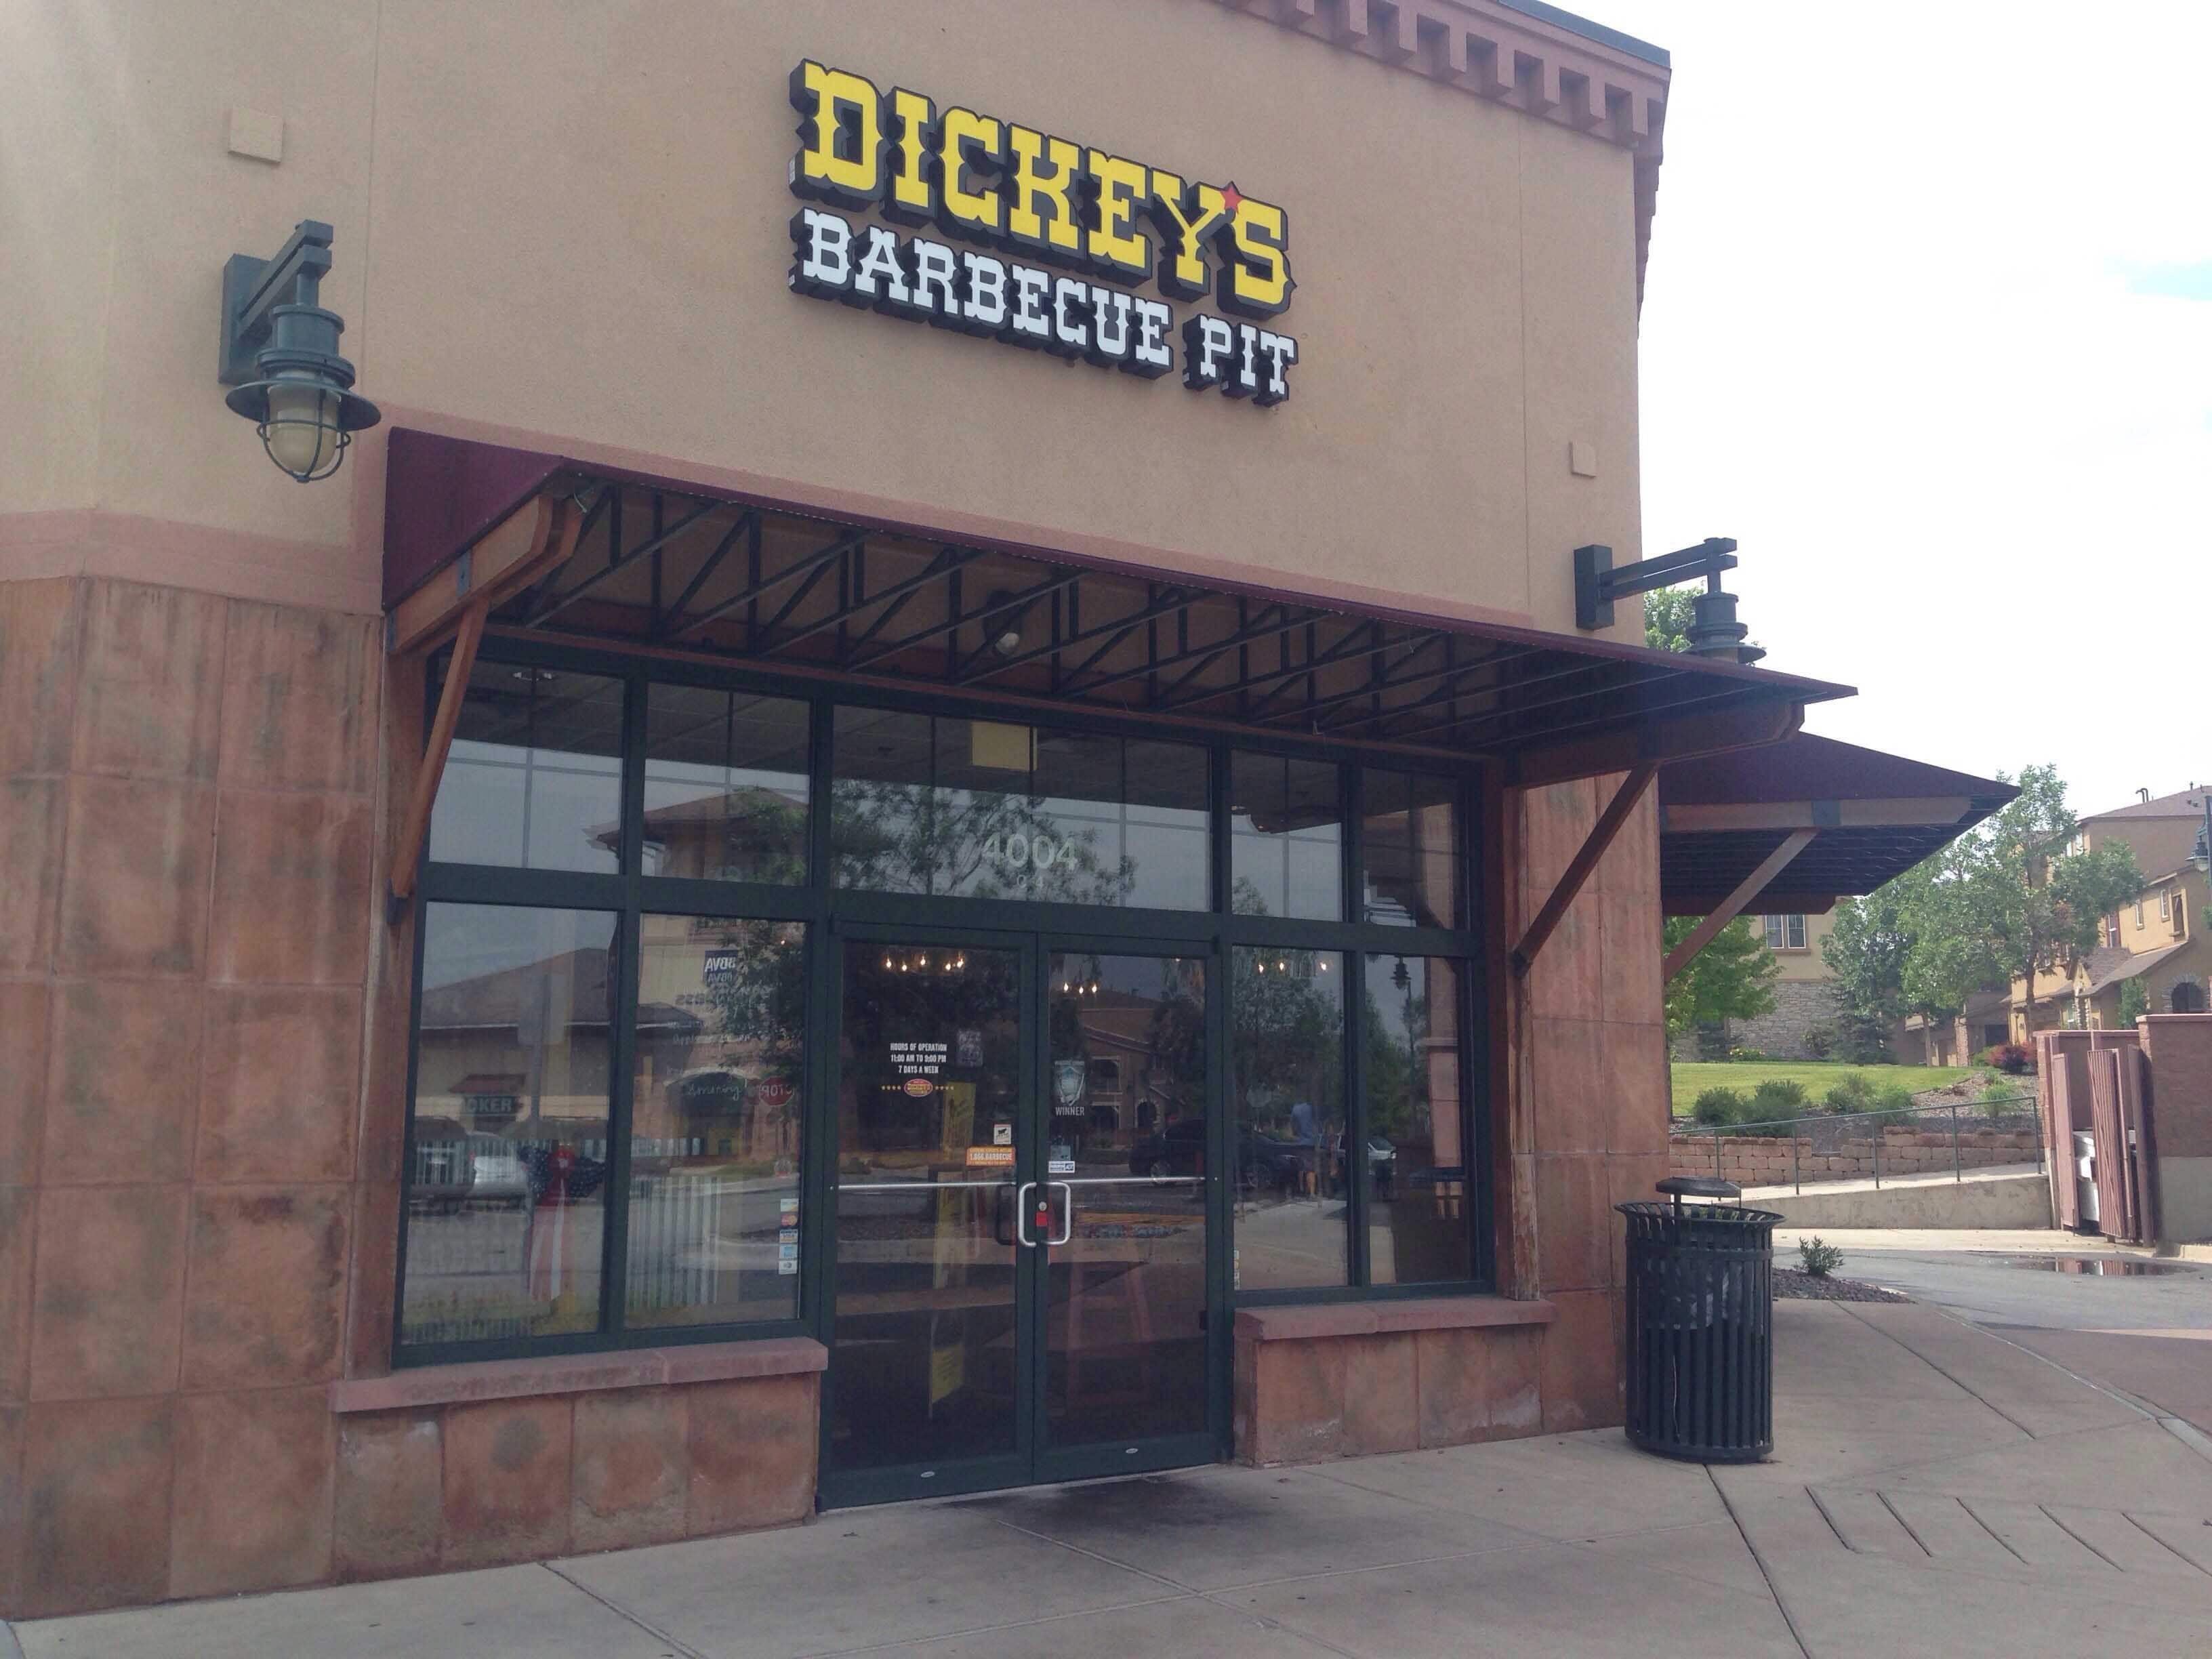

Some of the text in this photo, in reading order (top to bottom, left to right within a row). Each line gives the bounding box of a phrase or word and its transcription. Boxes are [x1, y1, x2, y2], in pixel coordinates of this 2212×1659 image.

[790, 59, 1296, 320] DICKEY'S
[789, 208, 1298, 406] BARBECUE PIT
[983, 833, 1078, 872] 4004
[890, 1043, 947, 1052] HOURS OF OPERATION
[890, 1054, 947, 1063] 11:00 AM TO 9:00 PM
[899, 1065, 939, 1074] 7 DAYS A WEEK
[1055, 1106, 1084, 1116] WINNER
